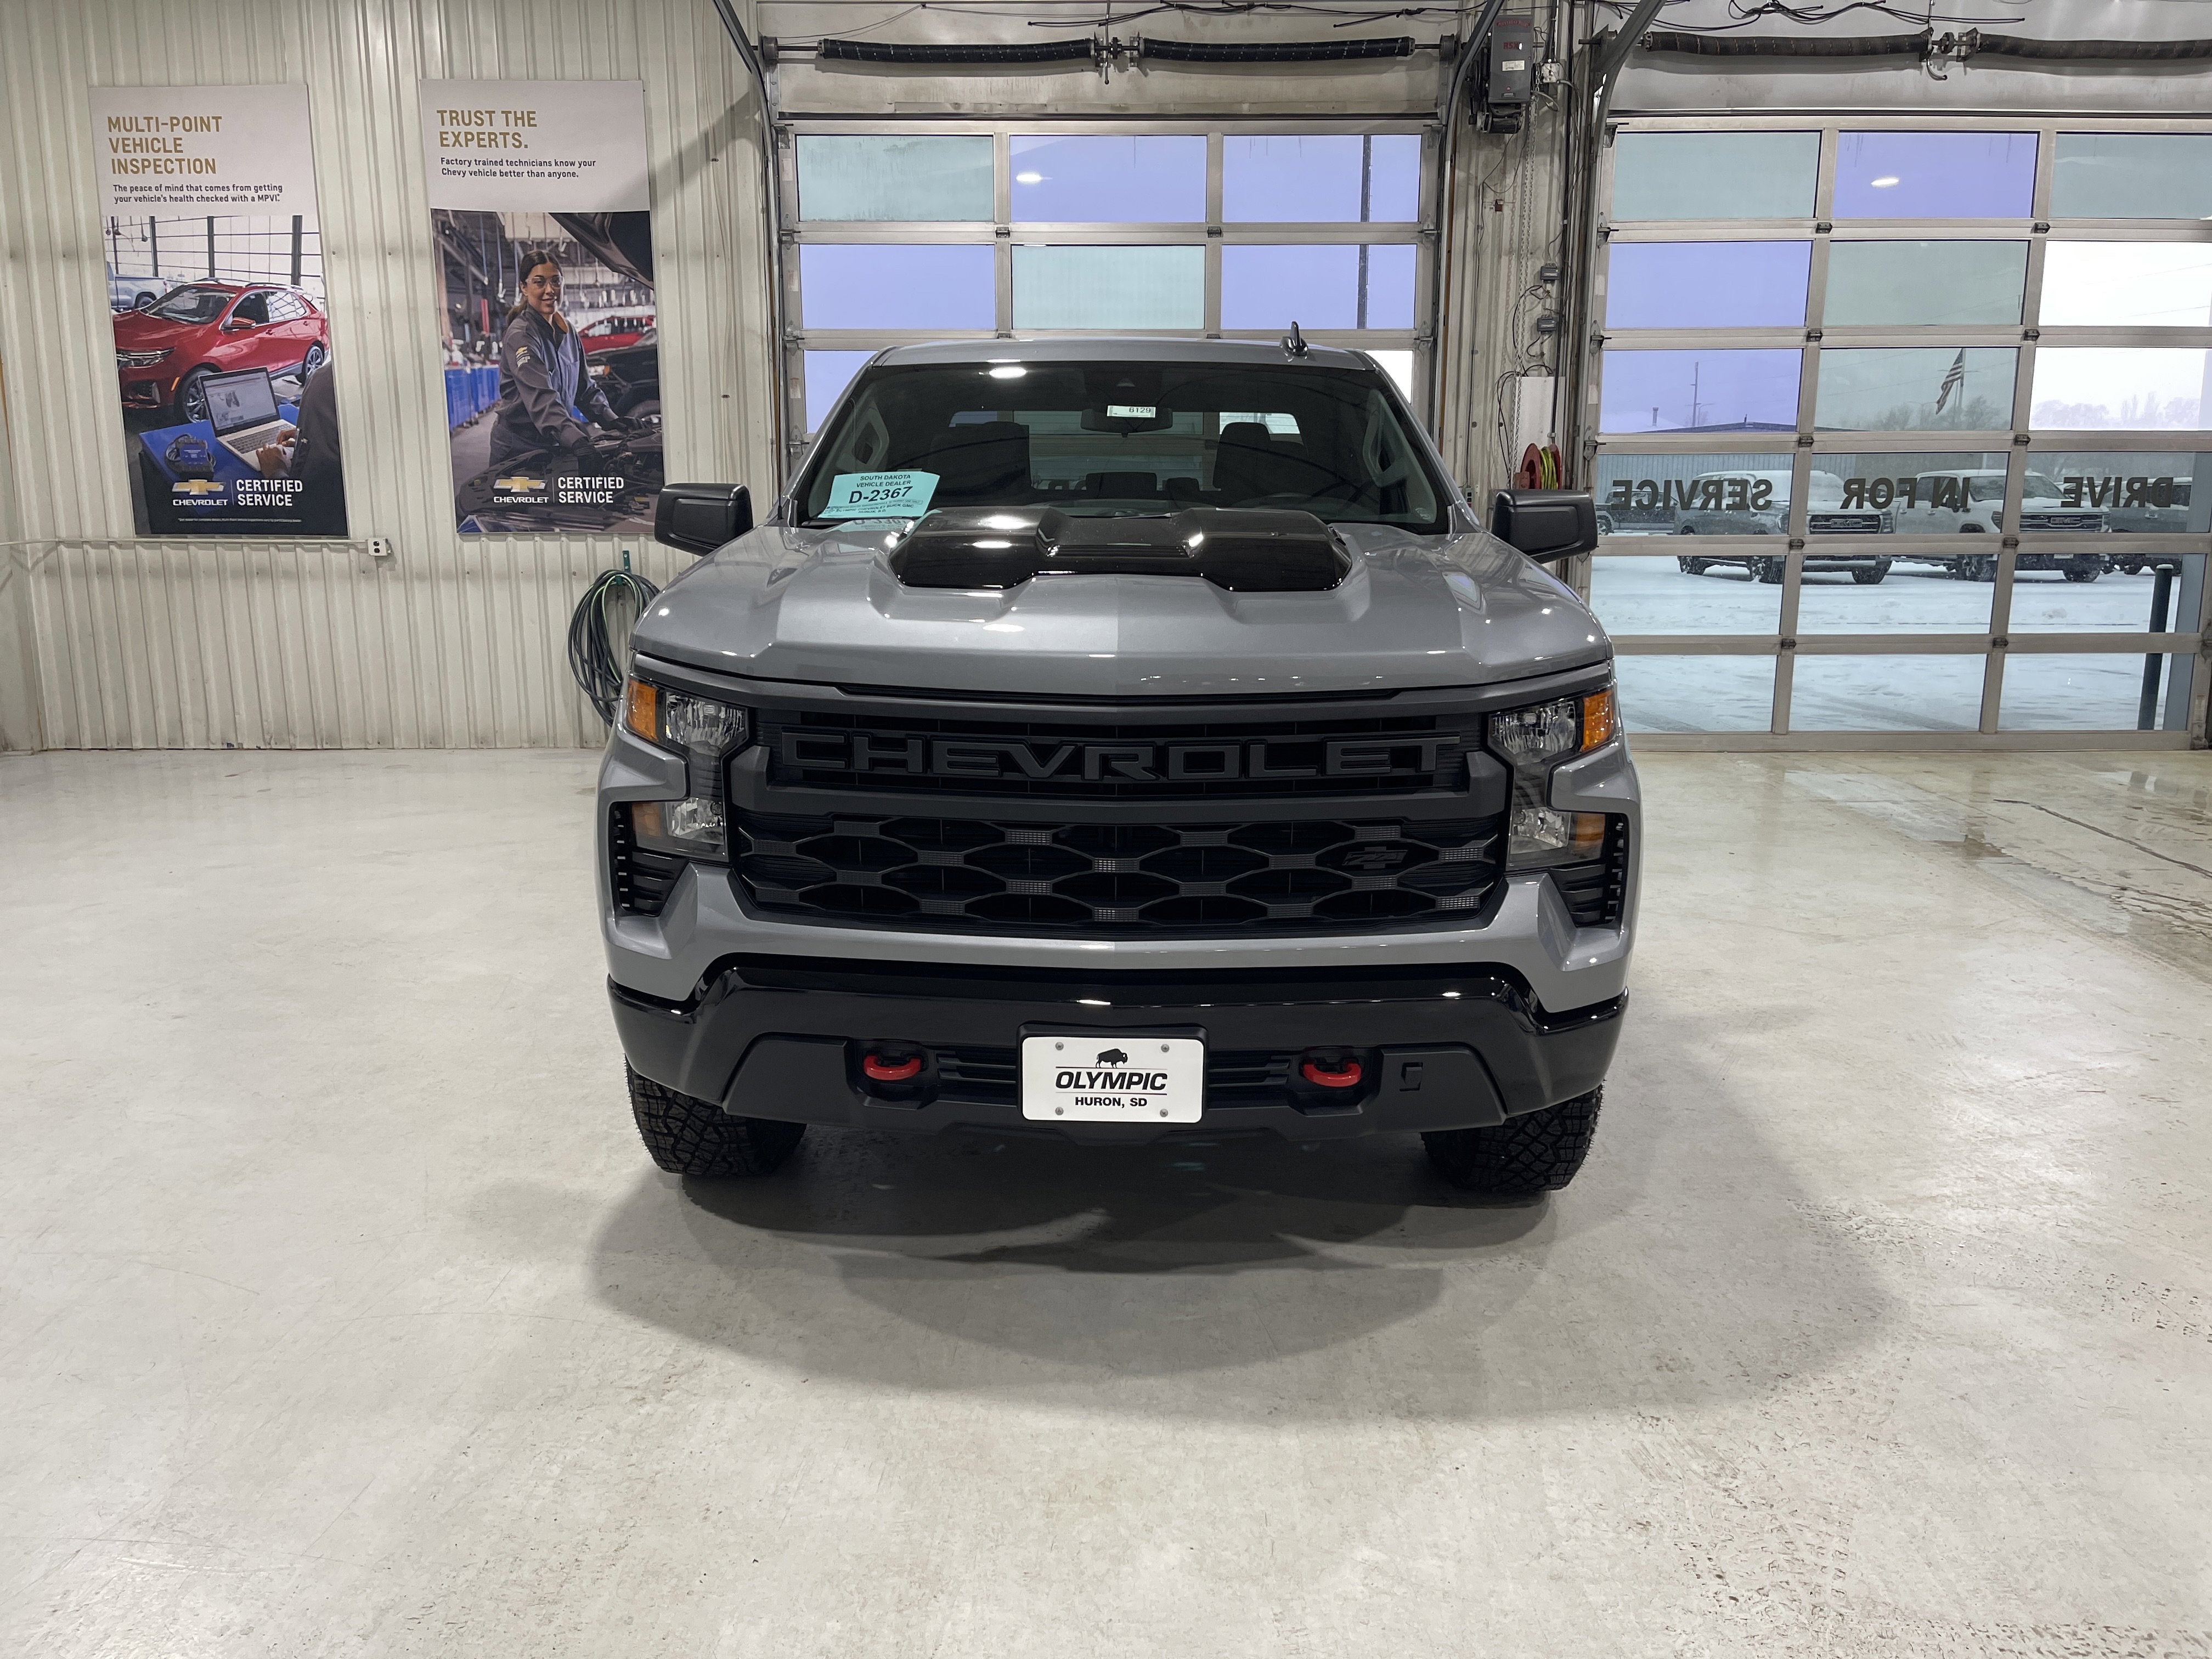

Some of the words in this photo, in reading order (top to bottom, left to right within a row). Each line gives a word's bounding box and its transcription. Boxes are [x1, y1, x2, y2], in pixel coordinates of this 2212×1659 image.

[108, 116, 222, 132] MULTI-POINT
[437, 110, 495, 126] TRUST
[501, 110, 537, 127] THE
[109, 137, 184, 153] VEHICLE
[439, 131, 528, 148] EXPERTS.
[111, 158, 216, 174] INSPECTION
[441, 157, 472, 167] Factory
[474, 158, 504, 166] trained
[505, 158, 552, 167] technicians
[554, 159, 575, 167] know
[578, 160, 596, 168] your
[442, 167, 466, 178] Chevy
[469, 168, 497, 177] vehicle
[499, 169, 524, 177] better
[527, 170, 545, 178] than
[548, 171, 579, 179] anyone.
[113, 184, 128, 192] The
[129, 185, 153, 194] peace
[155, 184, 162, 192] of
[165, 184, 184, 192] mind
[186, 184, 202, 192] that
[253, 183, 283, 193] getting
[114, 196, 132, 205] your
[134, 194, 167, 202] vehicle's
[169, 194, 194, 202] health
[236, 479, 303, 492] CERTIFIED
[557, 477, 624, 489] CERTIFIED
[238, 494, 292, 506] SERVICE
[558, 491, 614, 504] SERVICE
[849, 486, 913, 504] D-2367
[781, 731, 1461, 781] CHEVROLET
[1055, 1071, 1168, 1091] OLYMPIC
[1075, 1097, 1125, 1108] HURON,
[1130, 1098, 1148, 1107] SD
